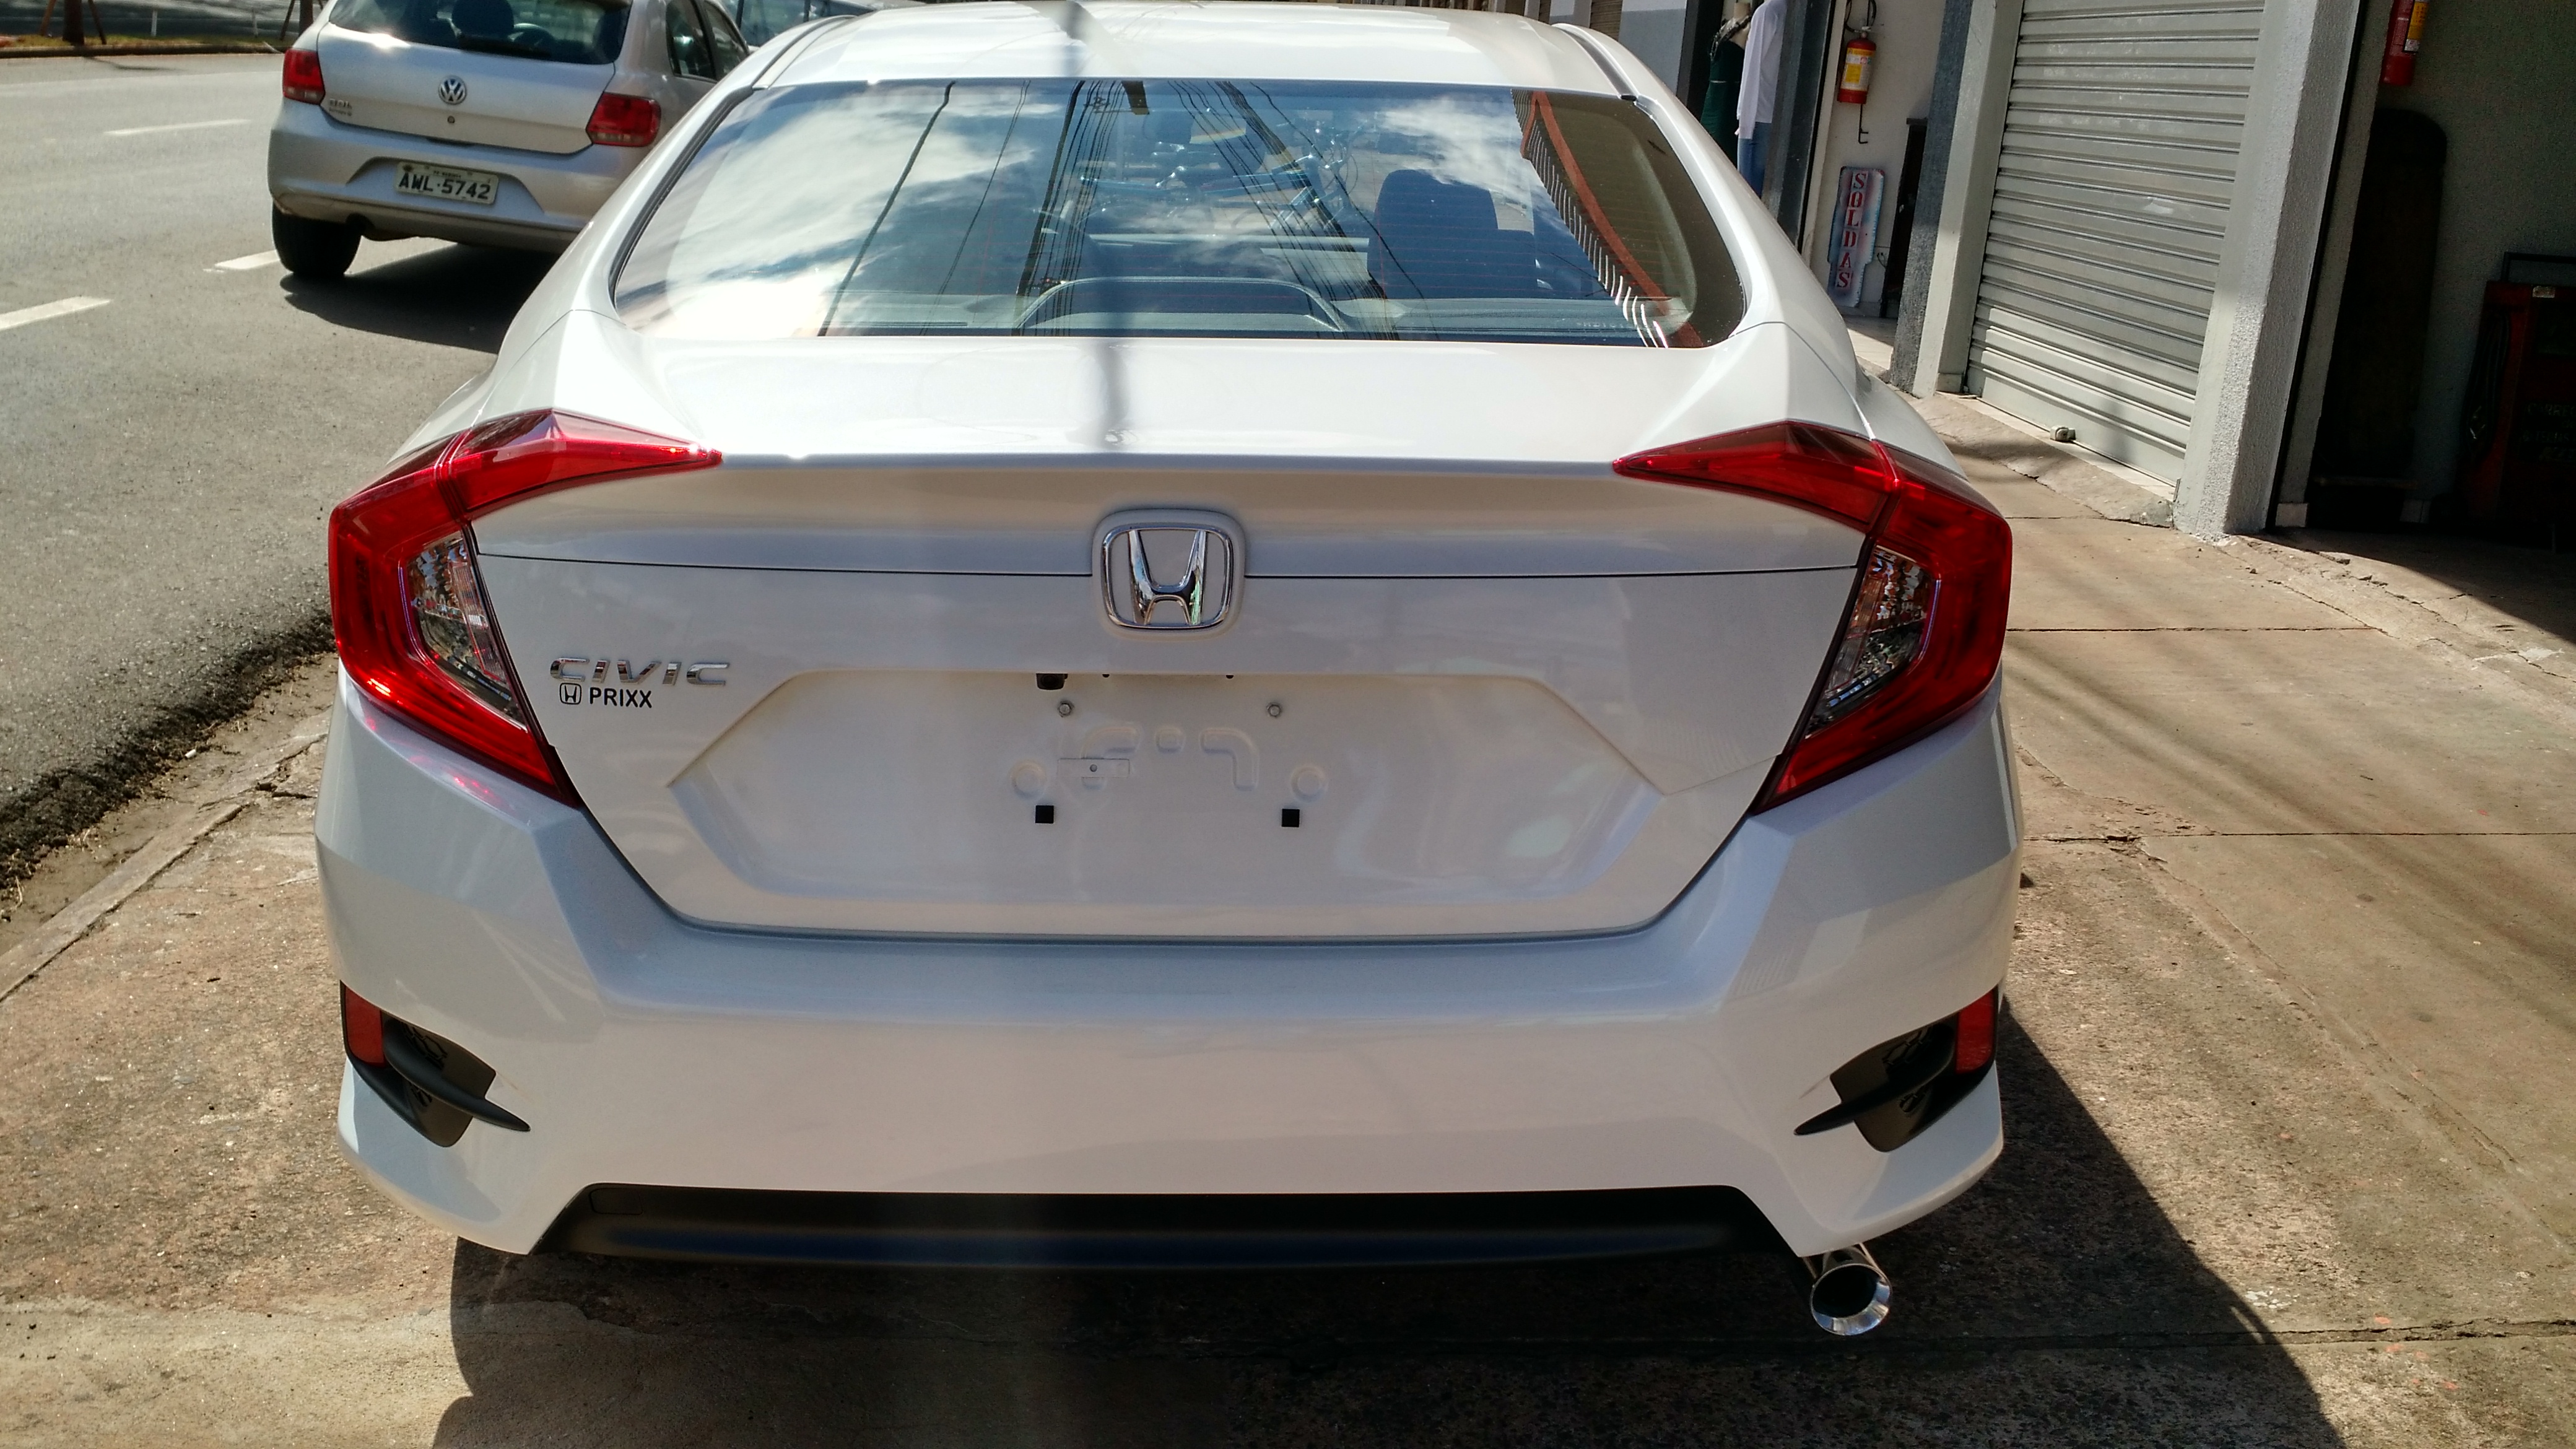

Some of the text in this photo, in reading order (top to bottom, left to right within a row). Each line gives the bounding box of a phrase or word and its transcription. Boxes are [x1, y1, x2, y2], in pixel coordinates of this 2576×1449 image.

[1837, 173, 1866, 288] SOLDAS
[550, 656, 730, 686] CIVIC
[590, 687, 653, 708] PRIXX
